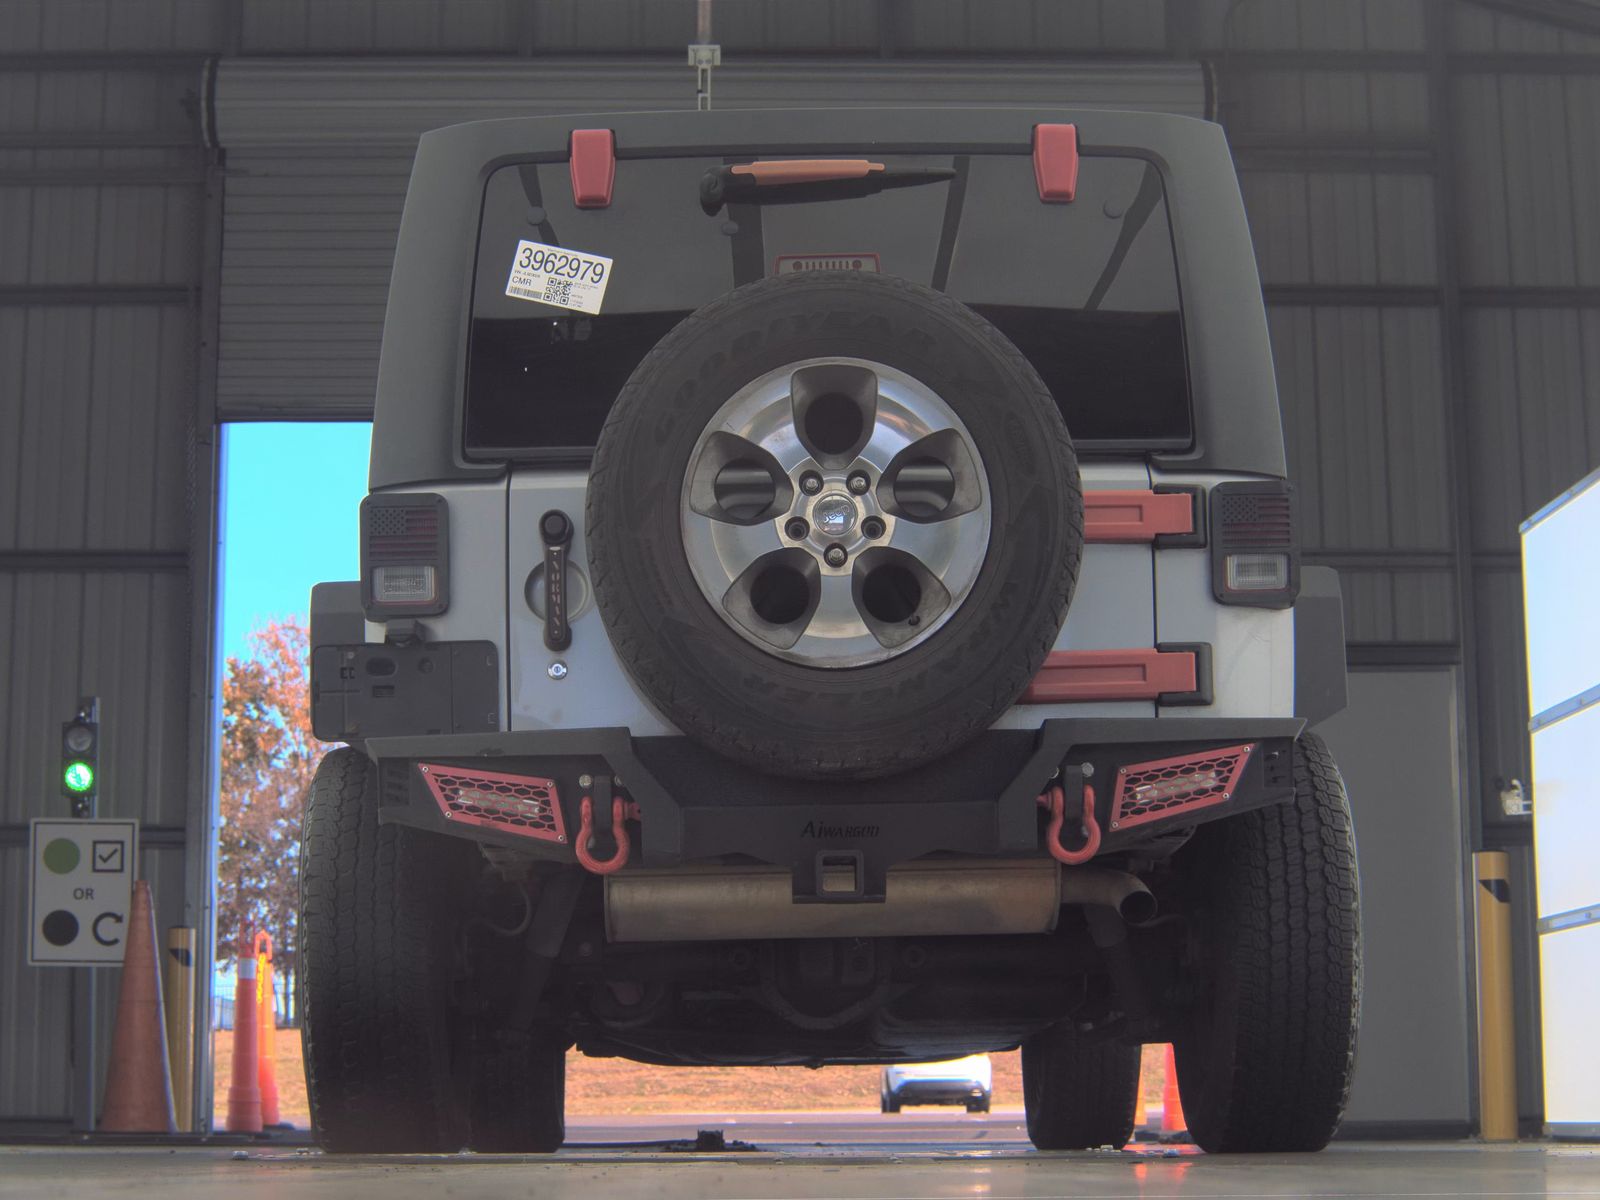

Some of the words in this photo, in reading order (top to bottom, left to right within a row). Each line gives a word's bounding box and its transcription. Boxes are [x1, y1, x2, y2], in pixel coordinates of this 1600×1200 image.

[519, 247, 605, 284] 3962979
[512, 276, 532, 286] CMR
[73, 887, 95, 901] OR
